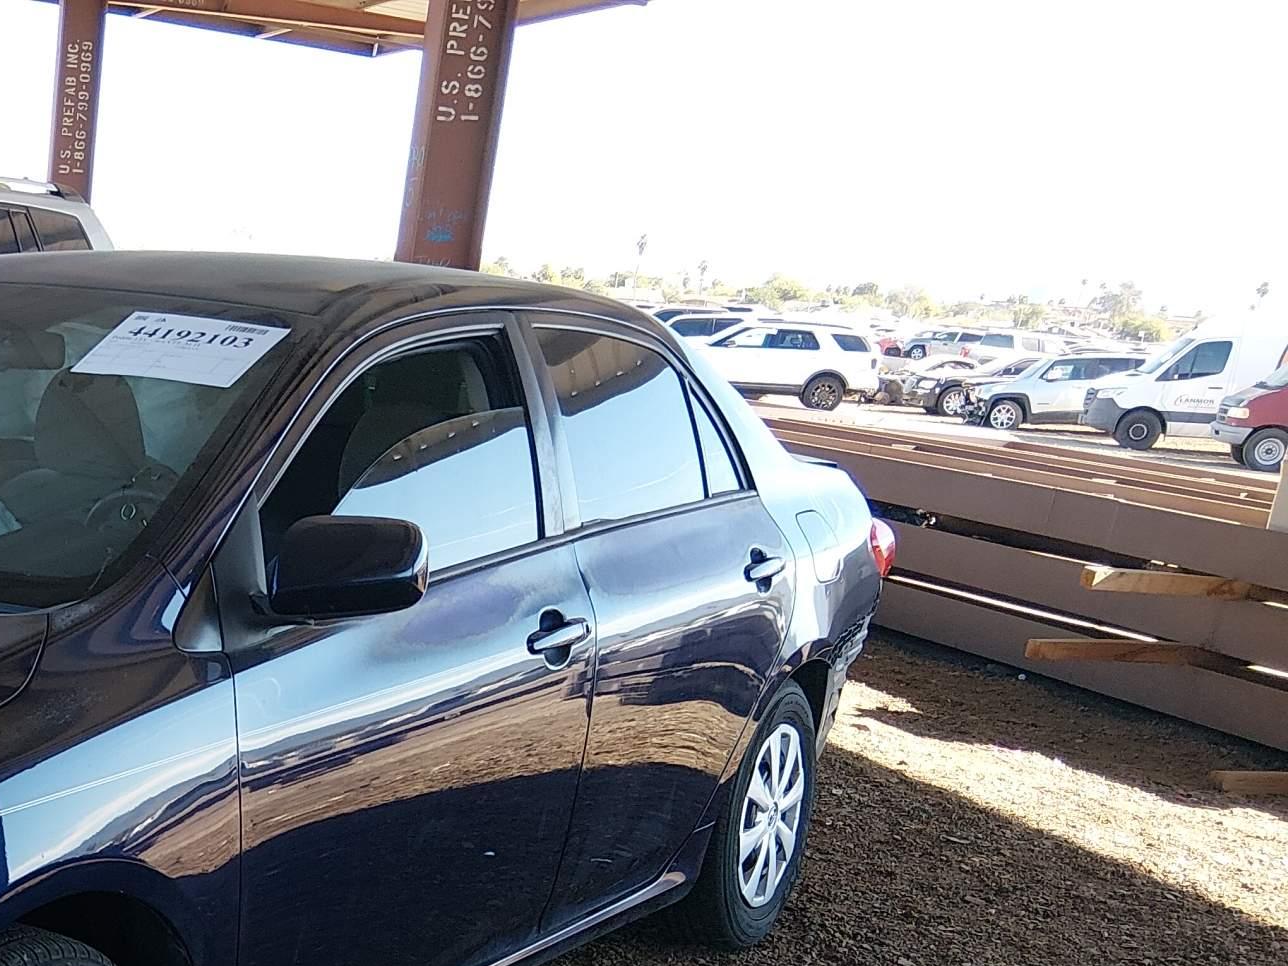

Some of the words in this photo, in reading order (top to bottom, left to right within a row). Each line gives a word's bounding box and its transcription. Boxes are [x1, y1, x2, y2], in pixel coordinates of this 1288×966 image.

[446, 0, 472, 56] PRE
[66, 39, 80, 69] INC.
[61, 76, 77, 137] PREFAB
[72, 40, 93, 174] 1-866-799-0969
[436, 72, 462, 122] U.S.
[58, 145, 72, 174] U.S.
[128, 324, 255, 349] 44192103
